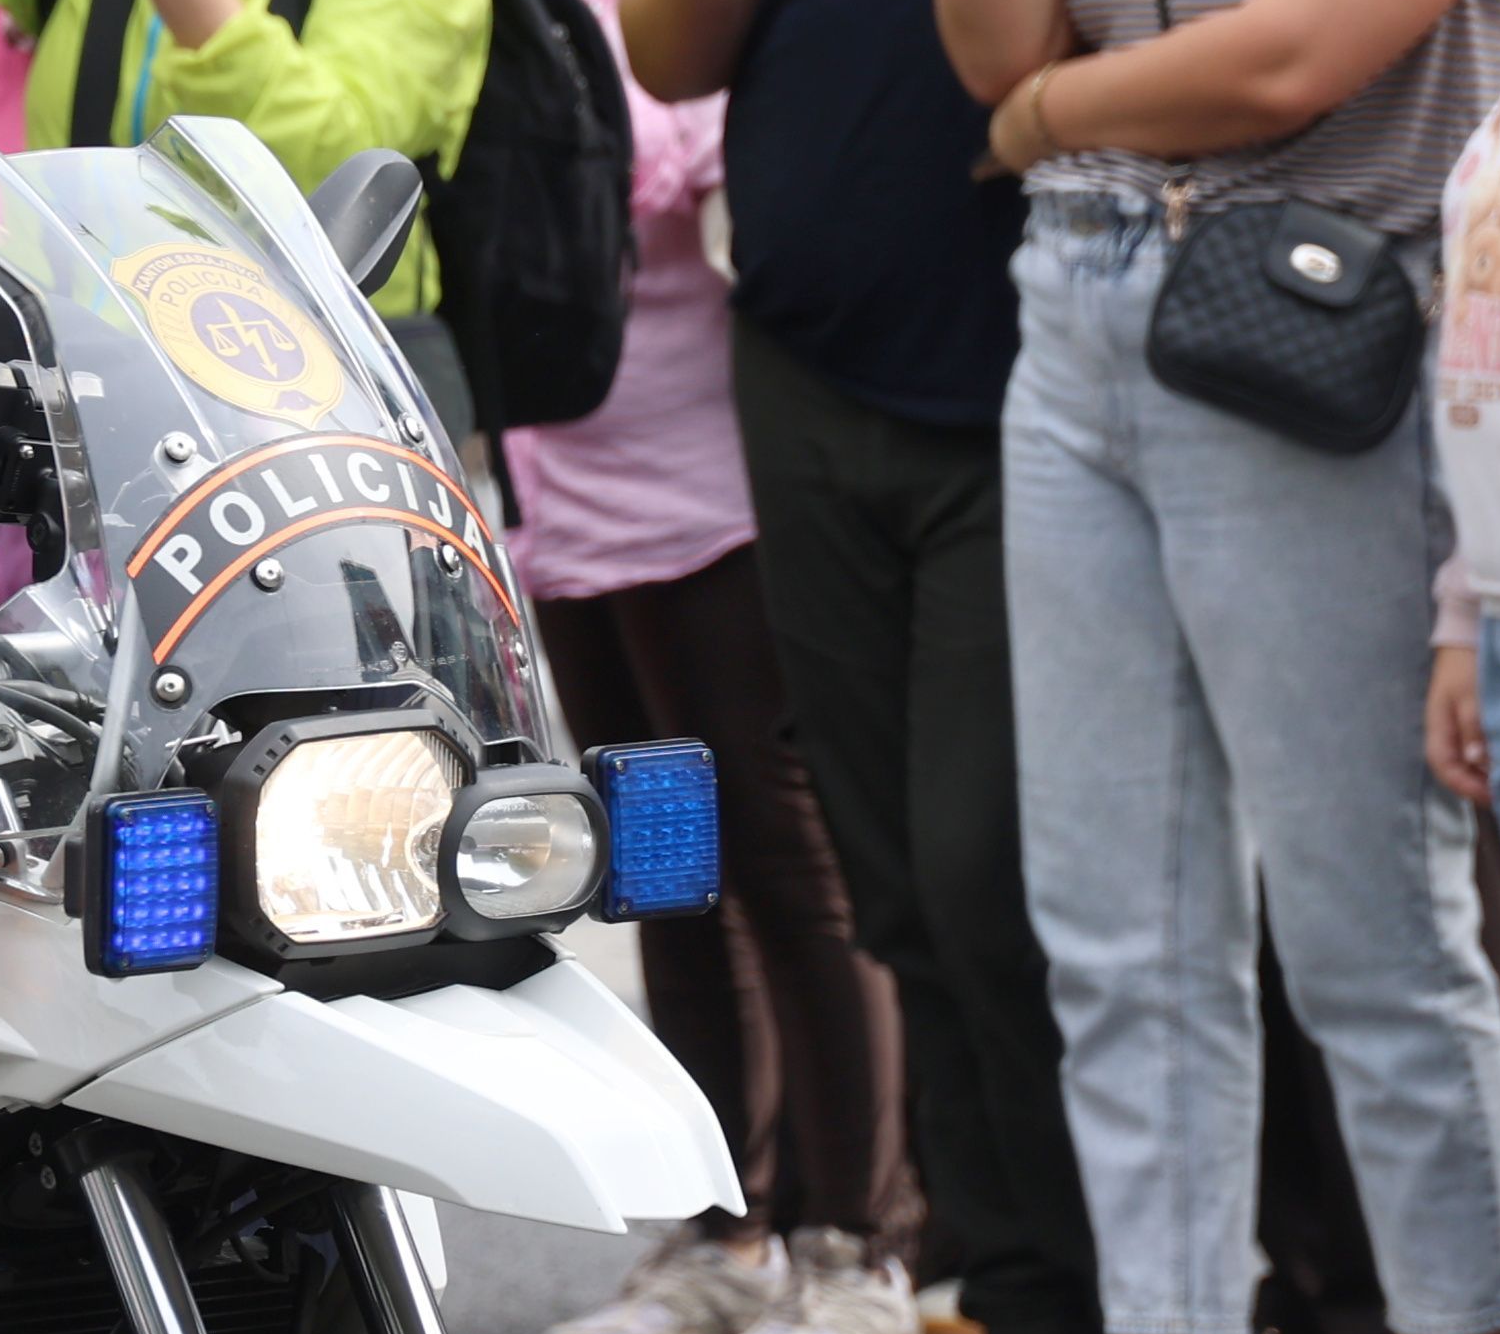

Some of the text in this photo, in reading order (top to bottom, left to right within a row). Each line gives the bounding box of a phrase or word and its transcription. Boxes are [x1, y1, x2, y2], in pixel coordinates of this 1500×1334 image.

[134, 254, 177, 292] KANTON
[159, 270, 265, 308] POLICIJA
[153, 452, 490, 596] POLICIJA
